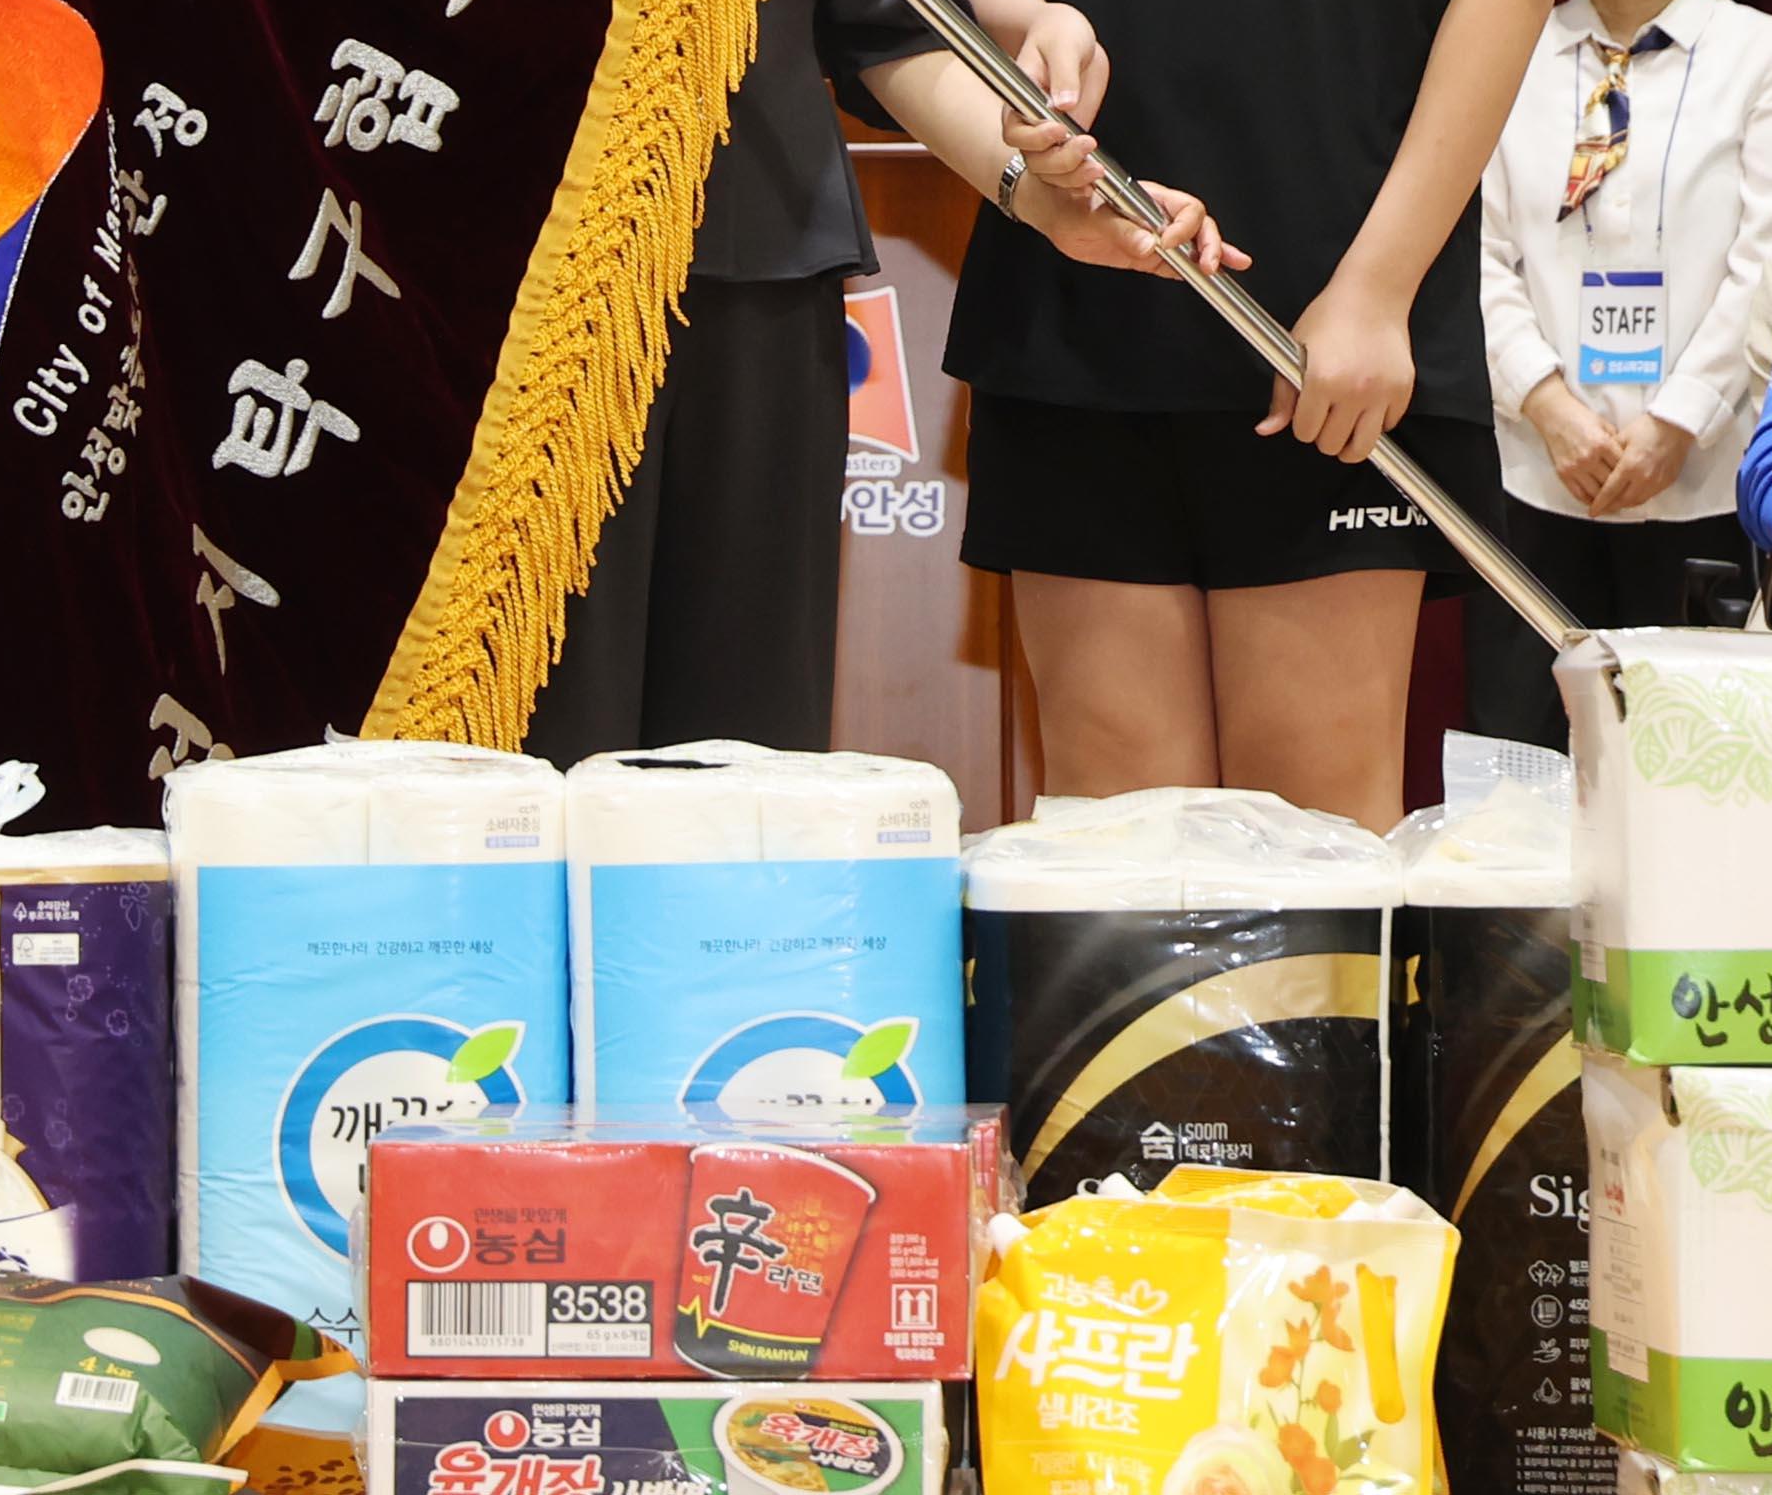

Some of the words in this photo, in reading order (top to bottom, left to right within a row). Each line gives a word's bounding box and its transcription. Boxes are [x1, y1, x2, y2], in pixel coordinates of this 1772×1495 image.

[78, 273, 114, 335] of
[1591, 305, 1656, 335] STAFF
[850, 485, 940, 531] 안성
[307, 940, 368, 956] 깨끗한나라
[376, 940, 425, 955] 건강하고
[428, 940, 466, 955] 깨끗한
[469, 940, 495, 955] 세상
[700, 938, 761, 953] 깨끗한나라
[862, 936, 887, 951] 세상
[1184, 1121, 1229, 1140] SOOM
[474, 1228, 568, 1266] 농심
[690, 1186, 788, 1318] 辛
[766, 1264, 824, 1295] 라면
[1041, 1271, 1117, 1307] 고농축
[551, 1285, 648, 1323] 3538
[78, 1355, 97, 1373] 4
[728, 1339, 754, 1358] SHIN
[755, 1342, 810, 1363] RAMYUN
[994, 1308, 1202, 1401] 샤프란
[532, 1403, 565, 1418] 인생을
[566, 1403, 602, 1418] 맛있게
[1037, 1392, 1141, 1436] 실내건조
[531, 1418, 602, 1448] 농심
[760, 1412, 878, 1459] 육개장
